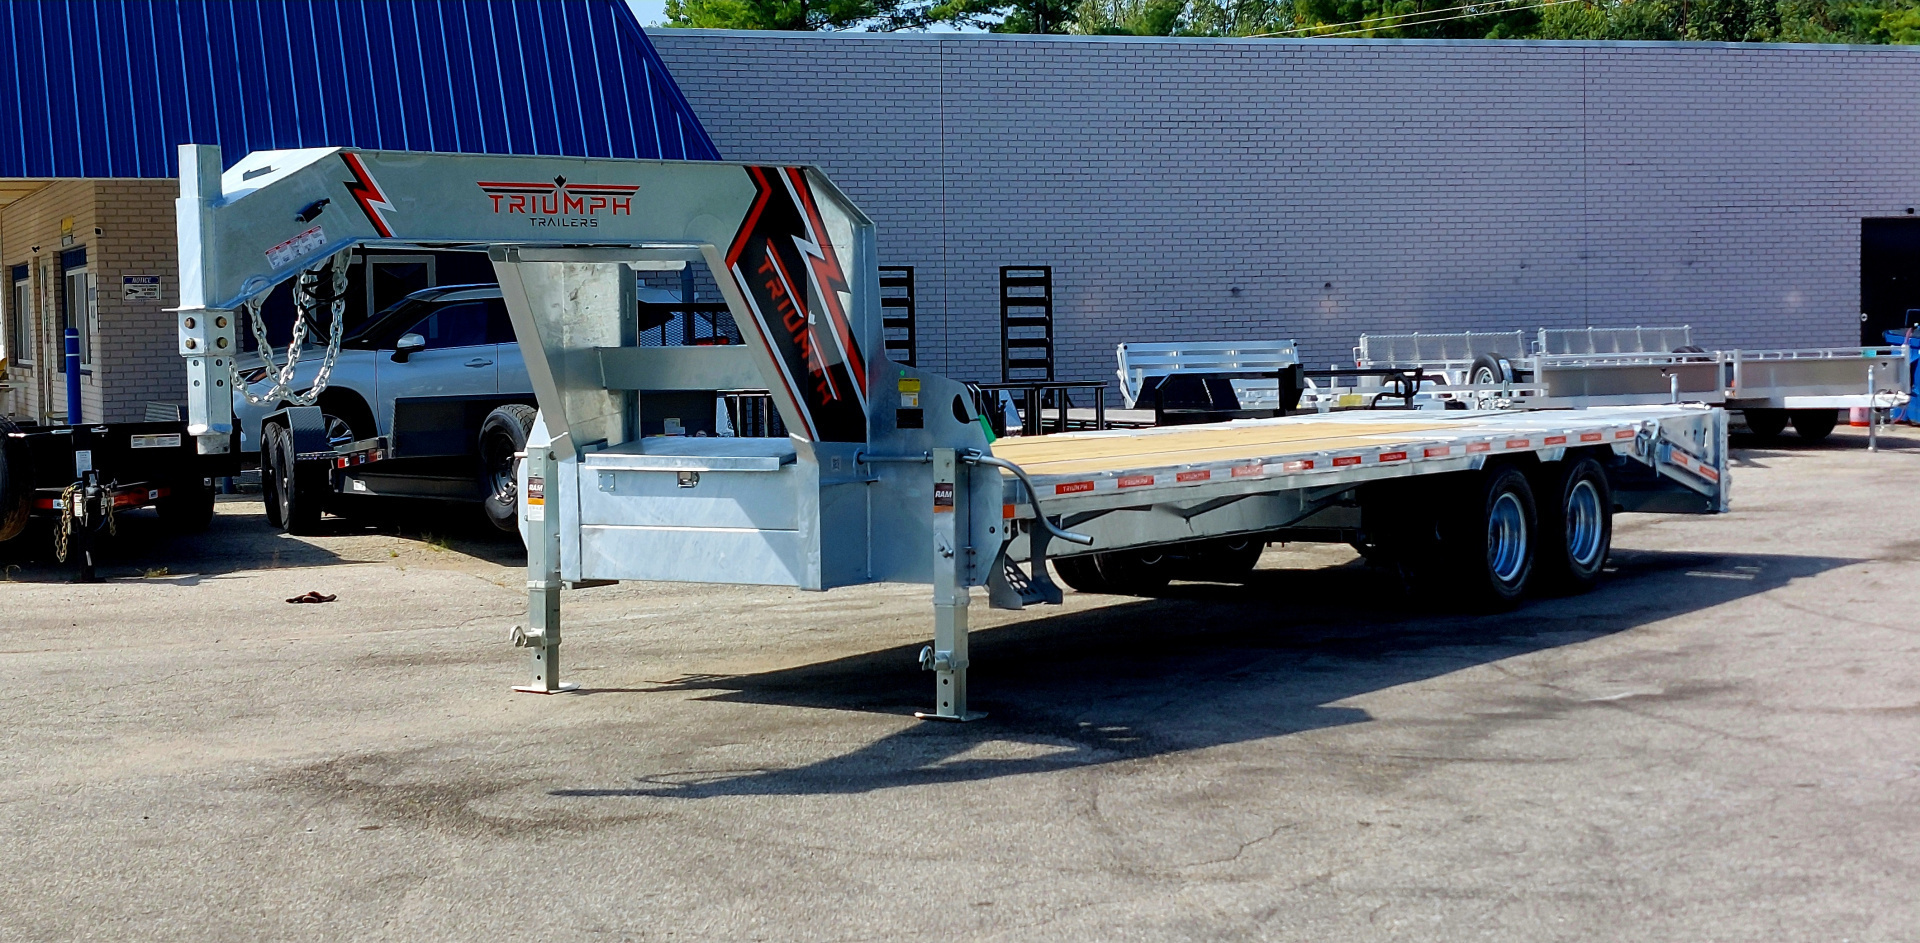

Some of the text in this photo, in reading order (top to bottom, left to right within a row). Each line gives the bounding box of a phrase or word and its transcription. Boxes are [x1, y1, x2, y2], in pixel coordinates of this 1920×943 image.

[487, 190, 631, 216] TRIUMPH
[529, 217, 598, 228] TRAILERS
[757, 253, 833, 406] TRIUMPH
[1062, 483, 1088, 493] TRIUMPH
[935, 490, 952, 498] RAM
